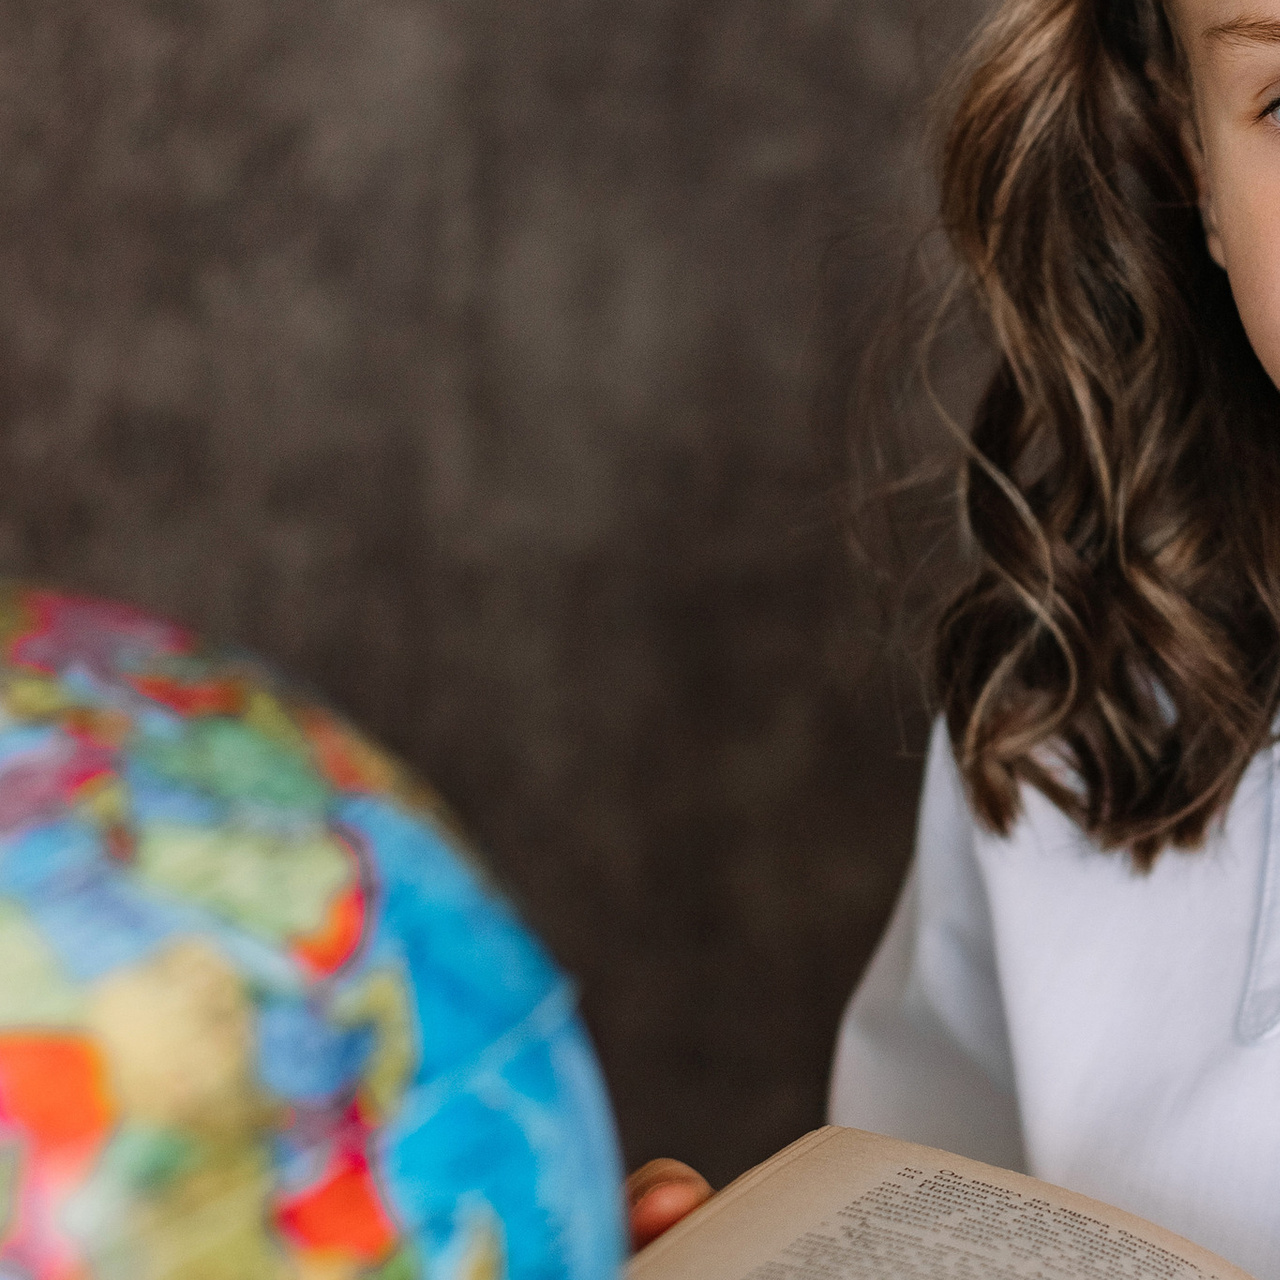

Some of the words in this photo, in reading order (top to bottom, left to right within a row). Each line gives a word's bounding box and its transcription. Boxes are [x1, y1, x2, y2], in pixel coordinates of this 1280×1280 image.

[921, 1178, 988, 1200] выборы
[933, 1174, 1010, 1200] банковых
[1022, 1201, 1087, 1226] билетов
[970, 1179, 1021, 1198] вынул
[1058, 1207, 1110, 1229] ящика
